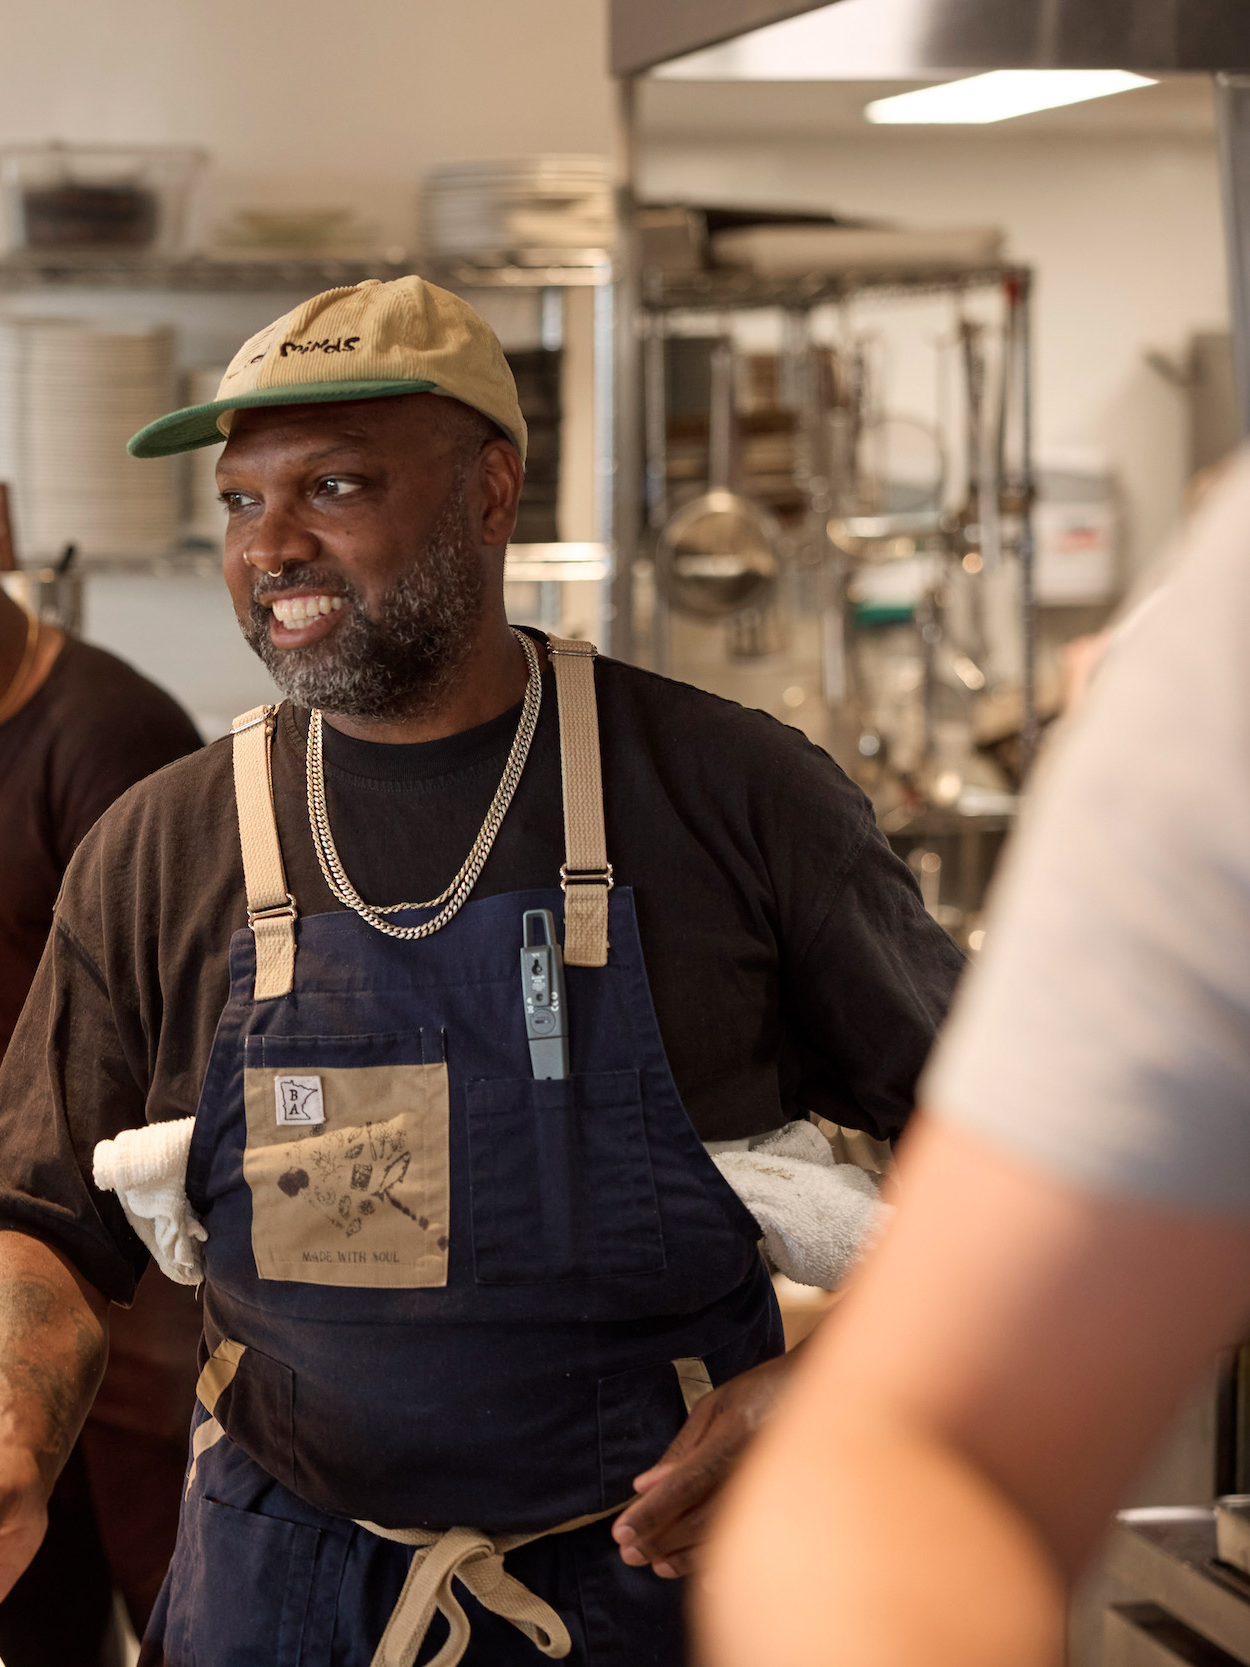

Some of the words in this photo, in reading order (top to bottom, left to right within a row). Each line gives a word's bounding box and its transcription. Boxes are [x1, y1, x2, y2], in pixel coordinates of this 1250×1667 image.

[290, 1089, 298, 1101] B
[289, 1103, 300, 1115] A
[302, 1251, 332, 1263] MADE
[337, 1251, 367, 1263] WITH
[372, 1251, 400, 1263] SOUL
